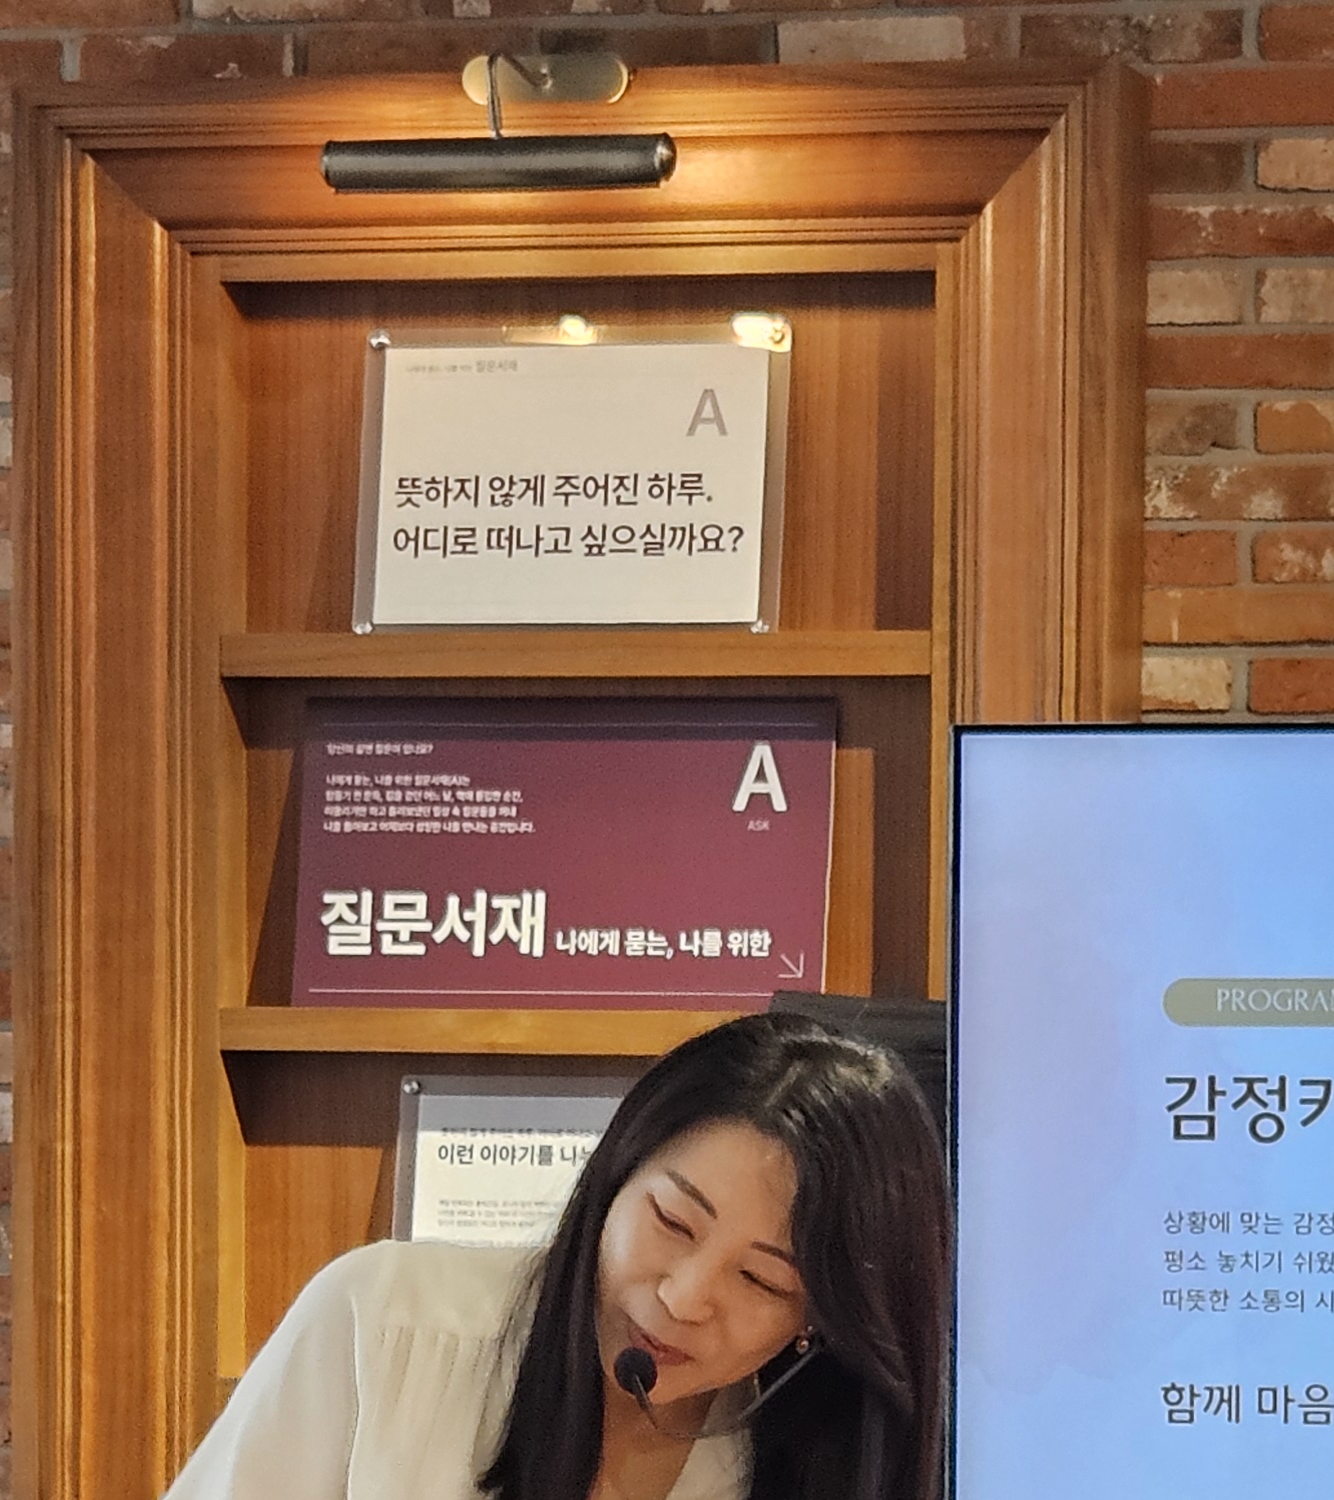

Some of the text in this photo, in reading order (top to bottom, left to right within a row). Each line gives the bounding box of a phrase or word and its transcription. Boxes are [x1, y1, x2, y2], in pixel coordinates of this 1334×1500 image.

[686, 389, 728, 436] A
[395, 475, 479, 508] 뜻하지
[489, 475, 545, 507] 않게
[553, 473, 638, 507] 주어진
[394, 523, 744, 558] 어디로 떠나고 싶으실까요?
[733, 742, 787, 811] A
[321, 890, 771, 959] 질문서재 나에게 묻는, 나를 위한
[438, 1144, 474, 1164] 이런
[480, 1144, 553, 1166] 이야기를
[1164, 1211, 1229, 1234] 상황에
[1240, 1212, 1282, 1234] 맞는
[1165, 1250, 1206, 1272] 평소
[1218, 1250, 1281, 1273] 놓치기
[1163, 1288, 1229, 1312] 따뜻한
[1240, 1290, 1304, 1313] 소통의
[1161, 1382, 1240, 1424] 함께
